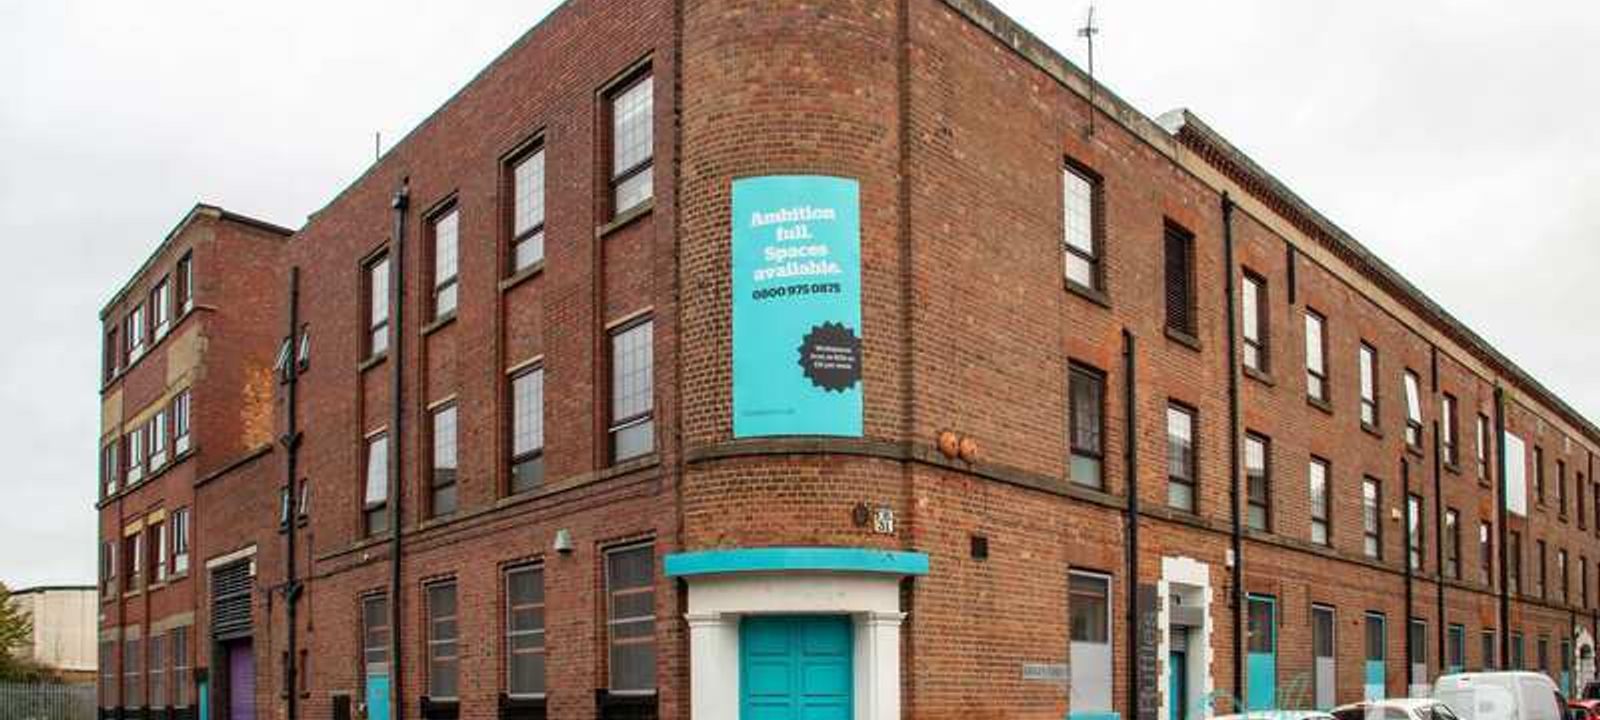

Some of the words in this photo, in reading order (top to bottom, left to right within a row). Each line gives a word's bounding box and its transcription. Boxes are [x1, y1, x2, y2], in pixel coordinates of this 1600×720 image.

[751, 205, 836, 227] Ambition
[776, 224, 813, 242] full.
[764, 244, 829, 261] Spaces
[753, 260, 843, 281] available.
[752, 287, 786, 300] 0800
[788, 284, 810, 297] 975
[811, 283, 842, 295] 0875
